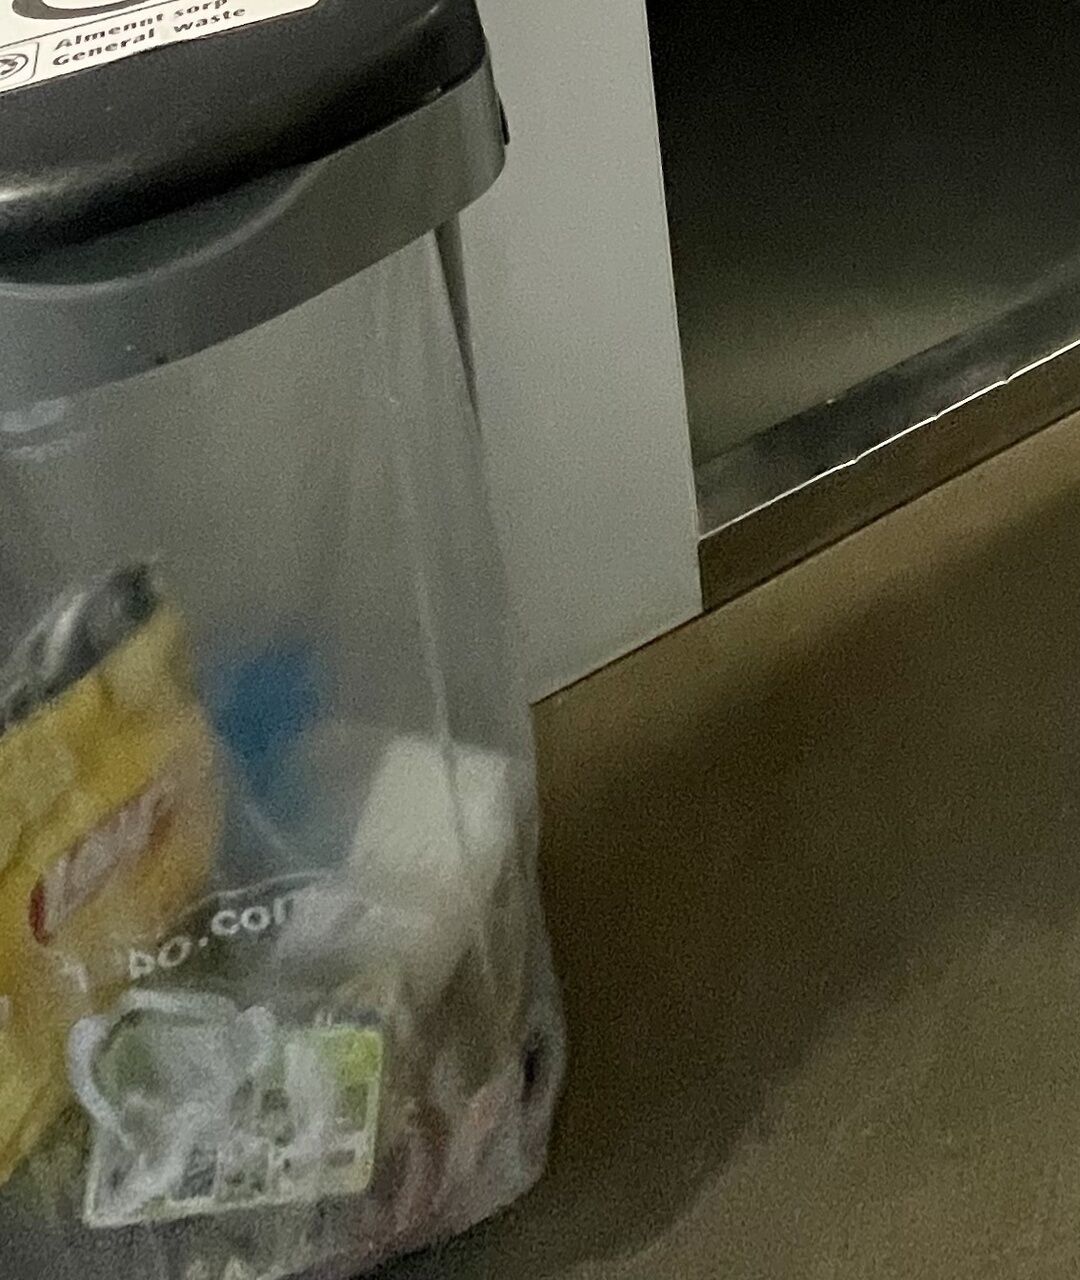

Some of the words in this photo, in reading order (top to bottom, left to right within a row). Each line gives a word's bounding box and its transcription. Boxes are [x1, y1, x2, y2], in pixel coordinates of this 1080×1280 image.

[52, 27, 156, 67] General
[173, 6, 247, 34] waste
[54, 12, 164, 51] Almennt
